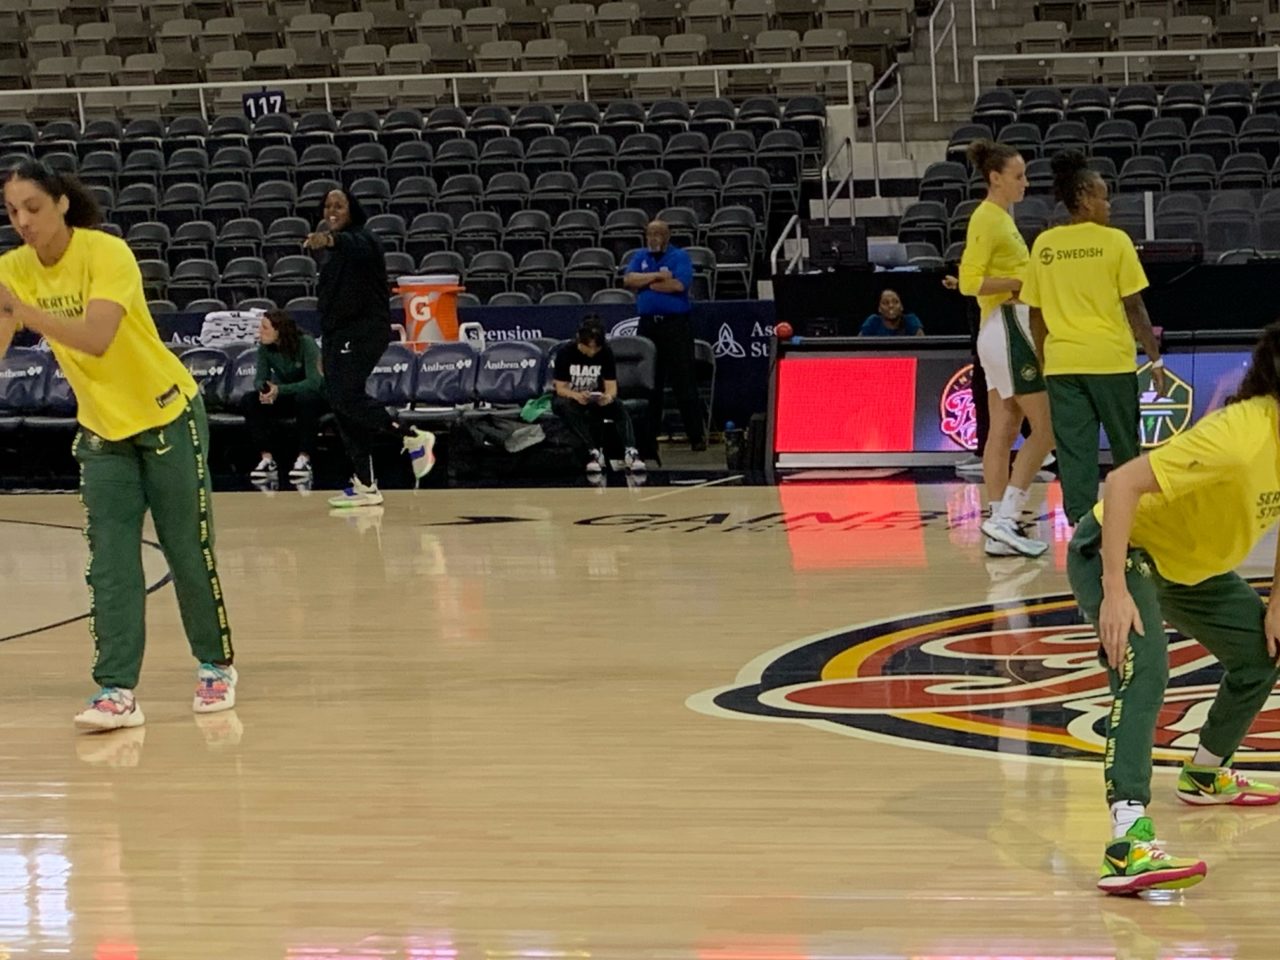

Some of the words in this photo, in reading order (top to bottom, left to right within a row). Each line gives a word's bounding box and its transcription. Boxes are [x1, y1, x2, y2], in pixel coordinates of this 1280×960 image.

[246, 95, 281, 118] 117
[1056, 248, 1103, 260] SWEDISH
[410, 296, 431, 321] G
[421, 361, 455, 373] Anthem
[484, 360, 519, 370] Anthem
[569, 364, 602, 377] BLACK
